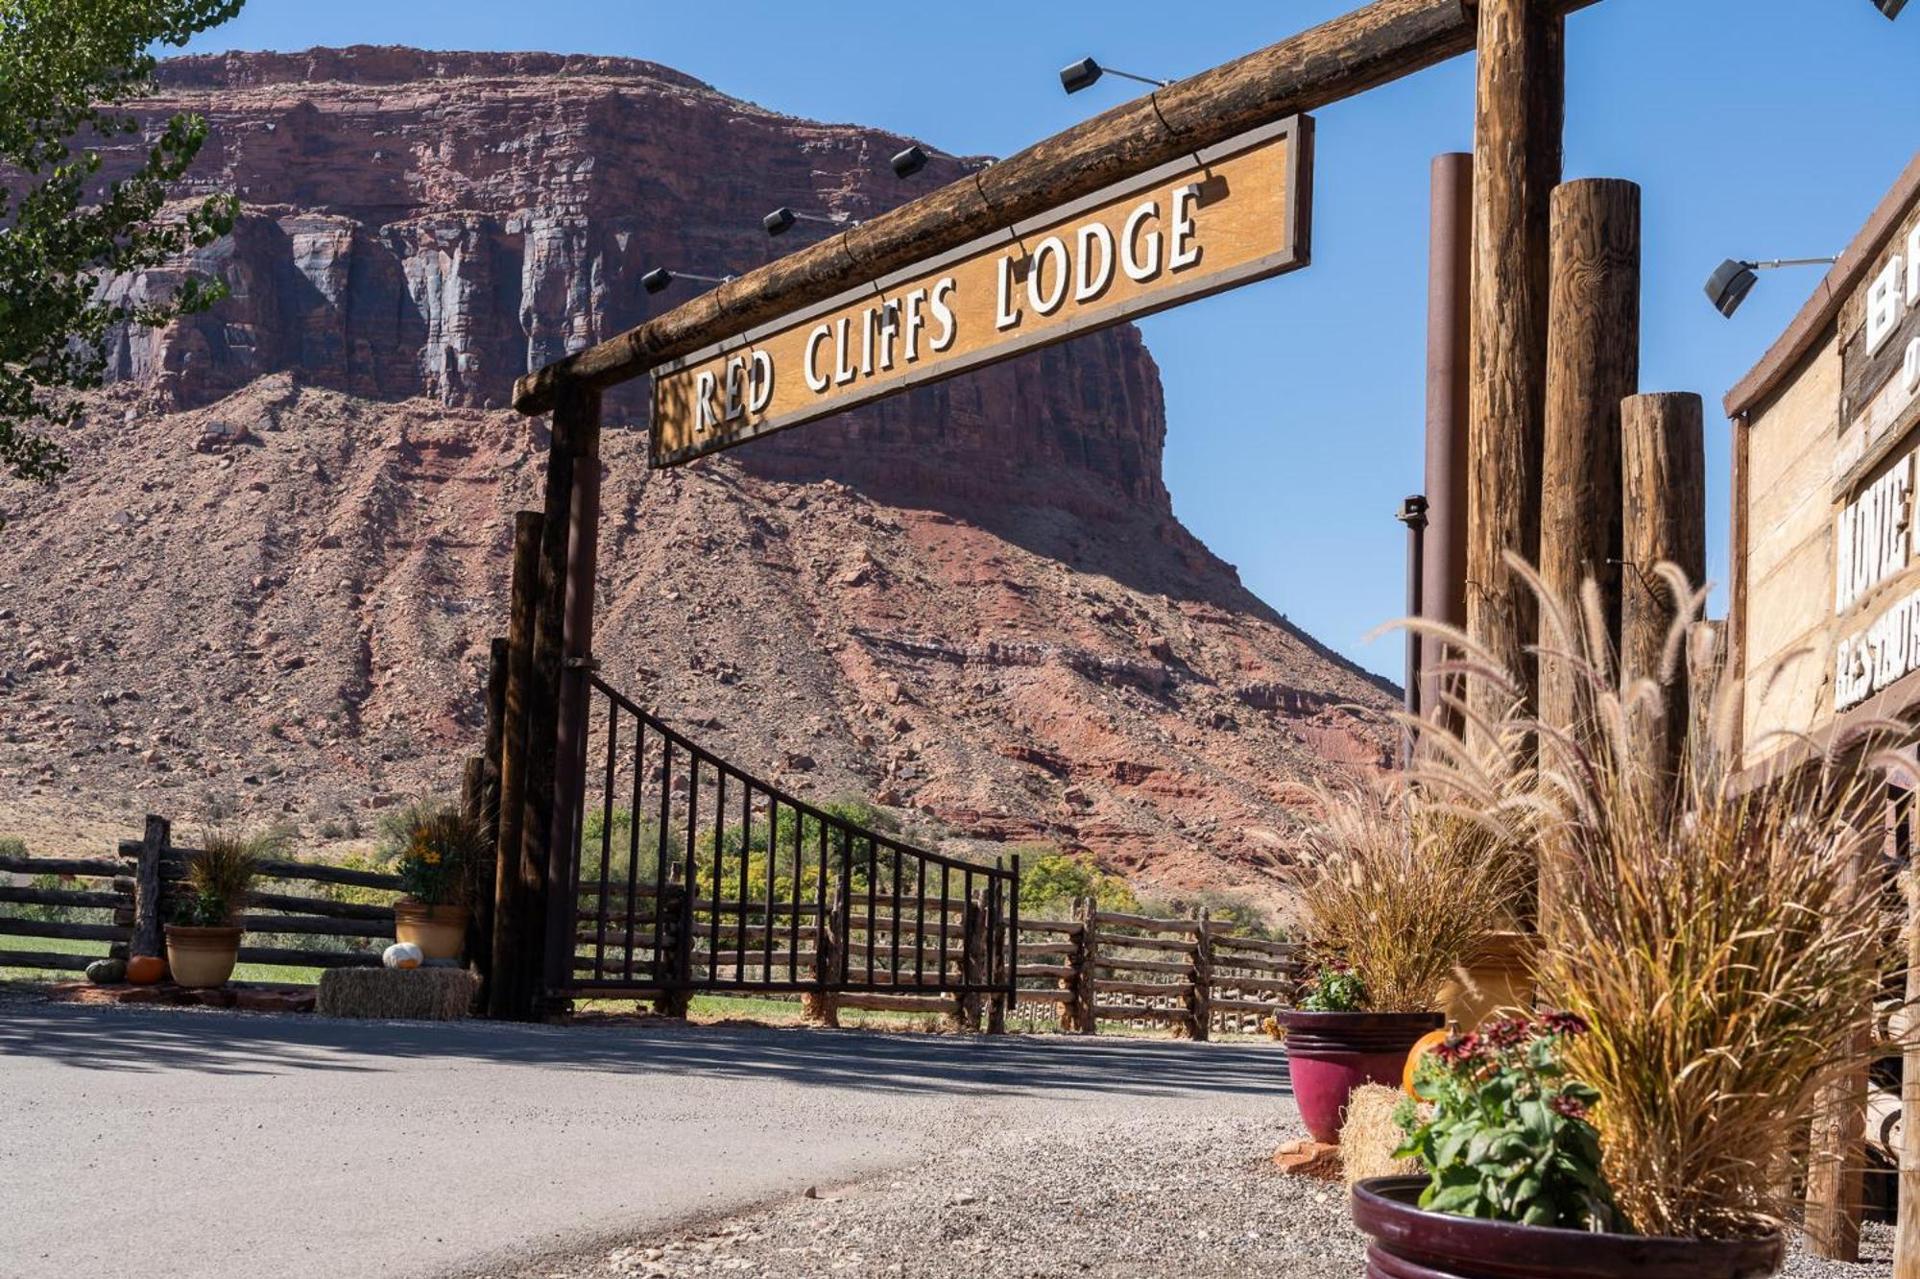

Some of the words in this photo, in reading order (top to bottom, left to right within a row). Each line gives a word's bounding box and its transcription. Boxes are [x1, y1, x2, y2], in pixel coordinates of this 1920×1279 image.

[695, 349, 773, 432] RED
[803, 276, 956, 394] CLIFFS
[995, 182, 1201, 330] LODGE
[1835, 450, 1913, 618] MOVIE
